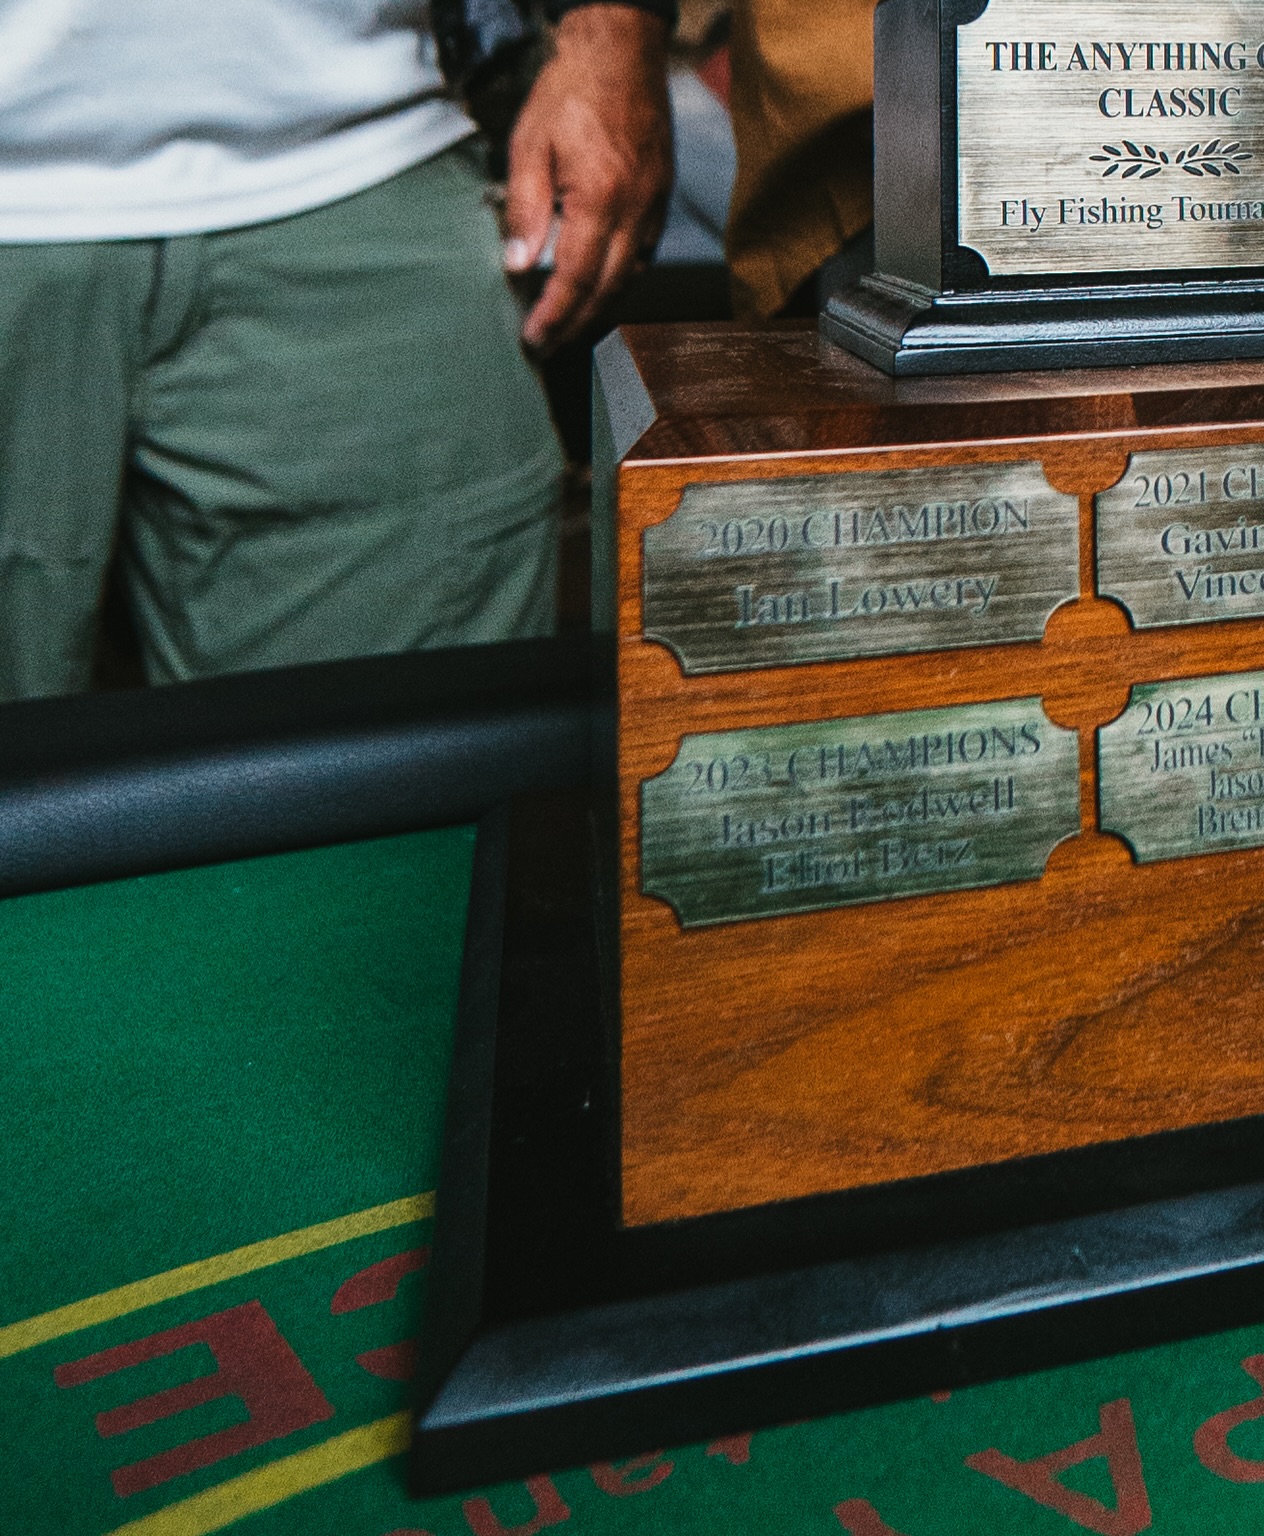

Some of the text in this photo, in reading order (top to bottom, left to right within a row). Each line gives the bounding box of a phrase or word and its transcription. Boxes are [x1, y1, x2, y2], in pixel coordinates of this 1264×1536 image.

[985, 41, 1057, 72] THE
[1066, 41, 1247, 72] ANYTHING
[1098, 86, 1242, 119] CLASSIC
[999, 198, 1047, 233] Fly
[1057, 196, 1163, 229] Fishing
[1133, 470, 1207, 509] 2021
[698, 498, 1032, 560] 2020 CHAMPION
[735, 574, 997, 629] Ian Lowery
[1135, 693, 1214, 737] 2024
[685, 720, 1042, 796] 2023 CHAMPIONS
[1150, 737, 1233, 774] James
[717, 810, 832, 850] Jason
